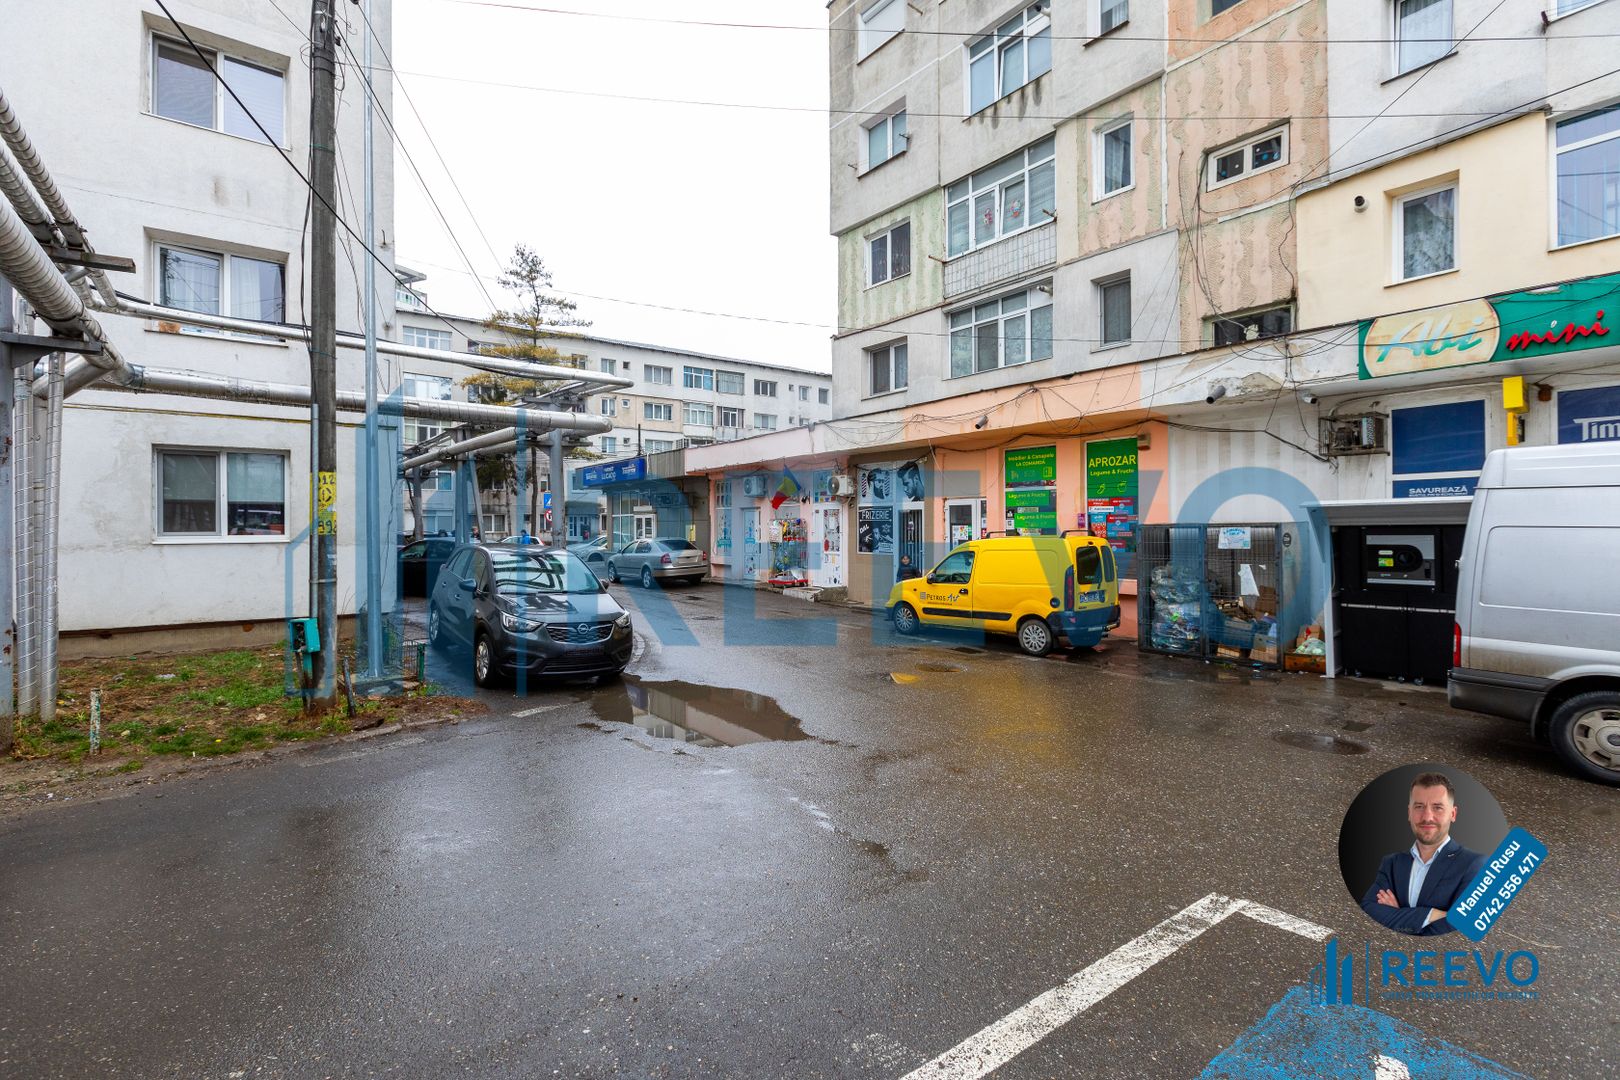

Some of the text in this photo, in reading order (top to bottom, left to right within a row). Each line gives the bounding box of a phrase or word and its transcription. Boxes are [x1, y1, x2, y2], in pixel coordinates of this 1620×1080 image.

[1506, 310, 1611, 351] mini
[1088, 454, 1137, 469] APROZAR
[1090, 469, 1111, 477] Legume
[1408, 485, 1468, 495] SAVUREAZĂ
[861, 510, 890, 520] FRIZERIE
